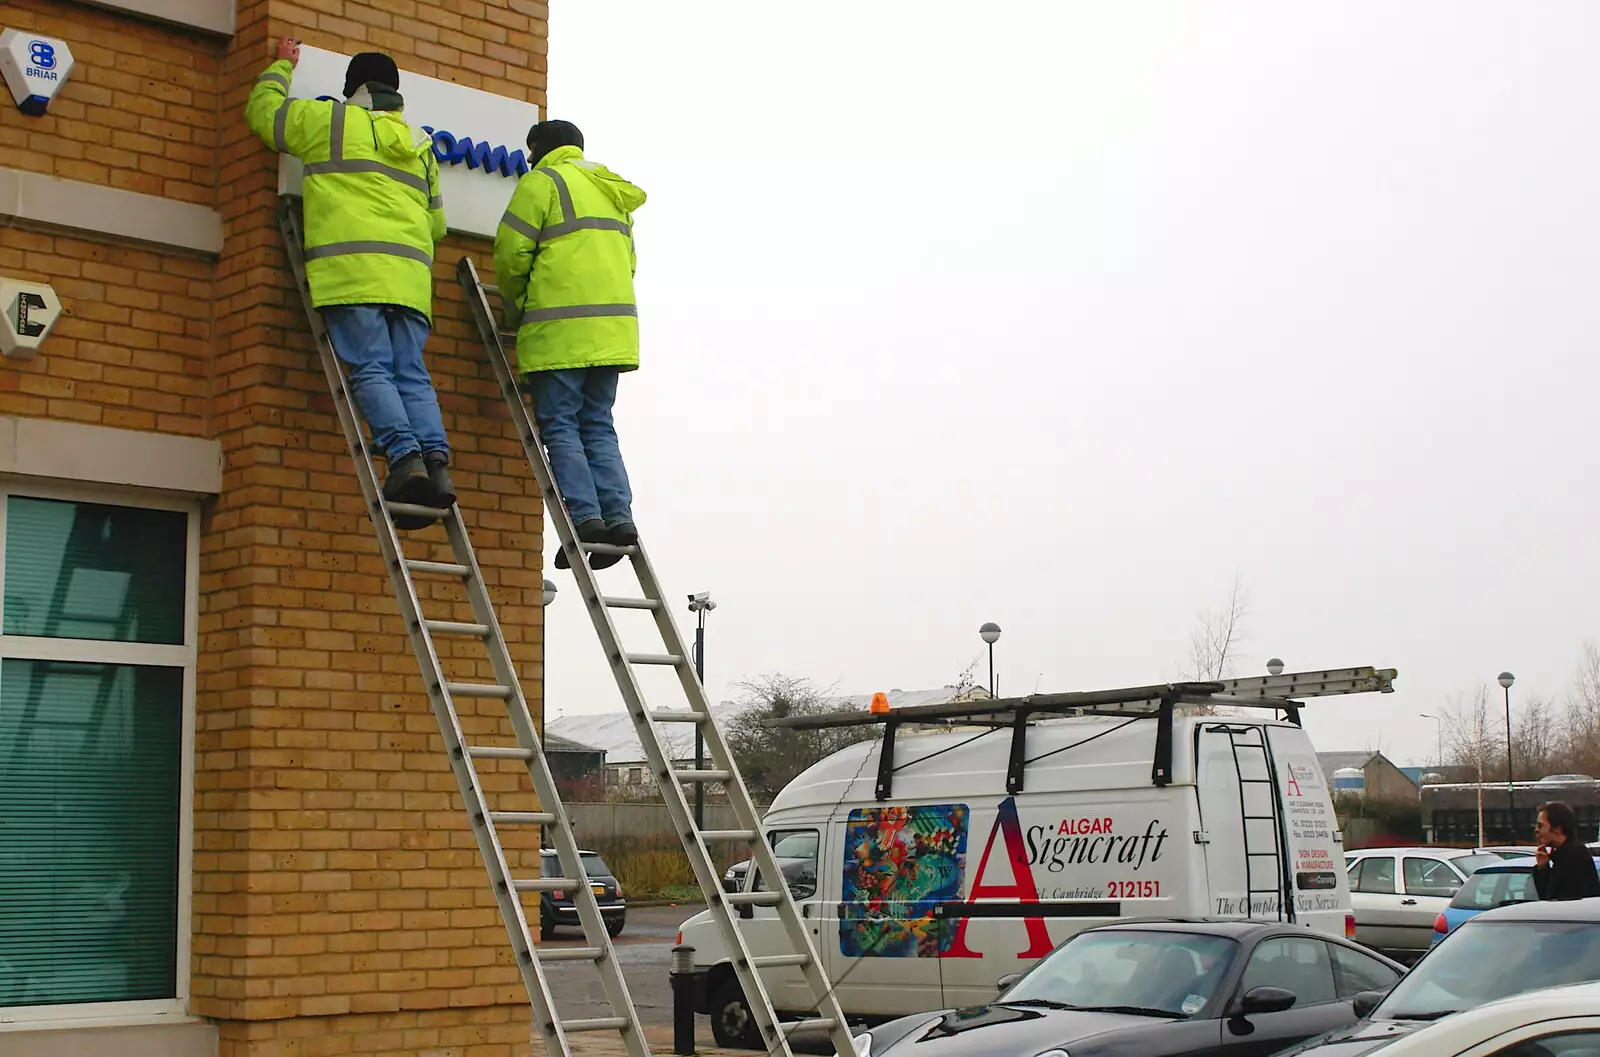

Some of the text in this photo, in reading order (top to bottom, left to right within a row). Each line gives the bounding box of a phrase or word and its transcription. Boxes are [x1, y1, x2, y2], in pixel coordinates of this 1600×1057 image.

[26, 67, 58, 81] BRIAR
[1057, 817, 1114, 835] ALGAR
[1017, 819, 1169, 873] Signcraft
[1052, 887, 1104, 899] Cambridge
[1107, 880, 1161, 898] 212151
[1216, 897, 1235, 915] The
